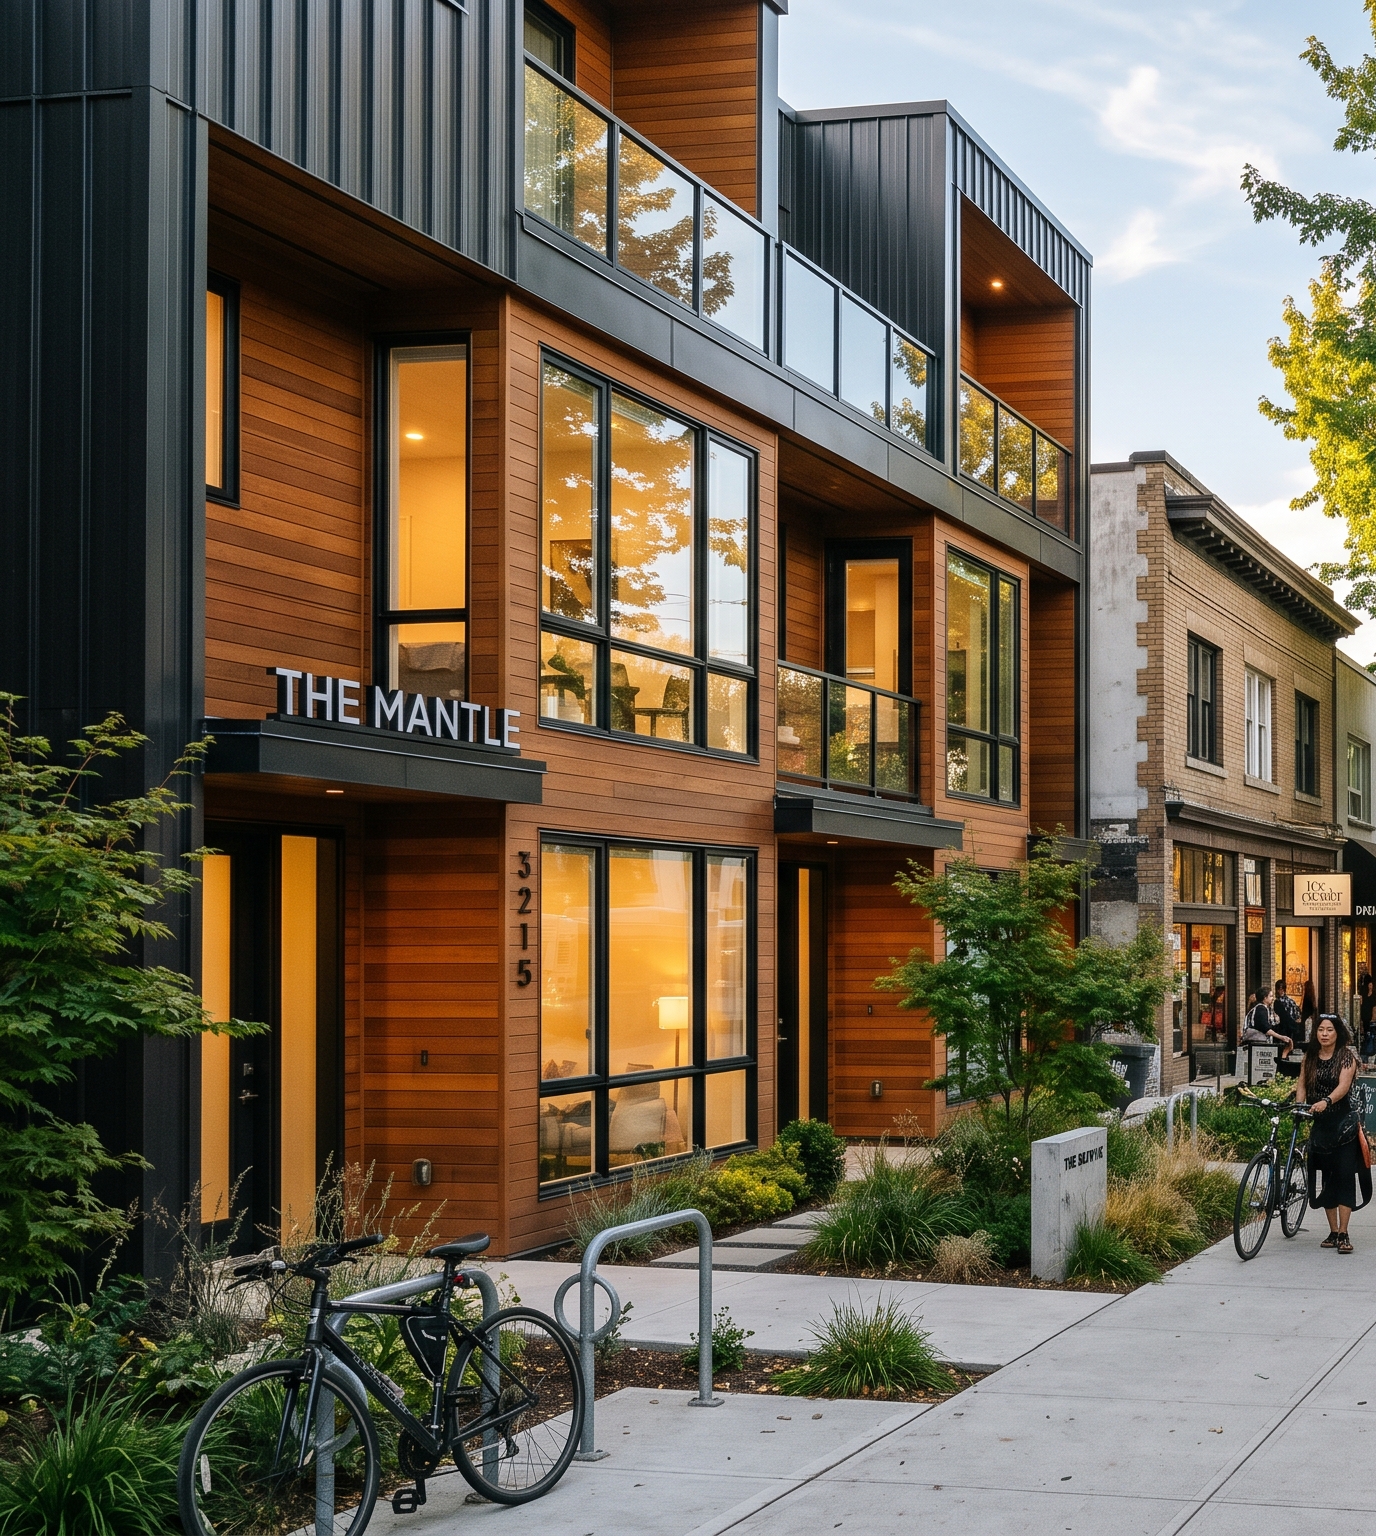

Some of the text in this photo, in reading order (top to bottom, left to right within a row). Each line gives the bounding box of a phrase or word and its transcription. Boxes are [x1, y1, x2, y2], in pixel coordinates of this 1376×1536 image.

[275, 667, 521, 750] THE MANTLE
[517, 851, 532, 987] 3215
[1063, 1154, 1077, 1171] THE
